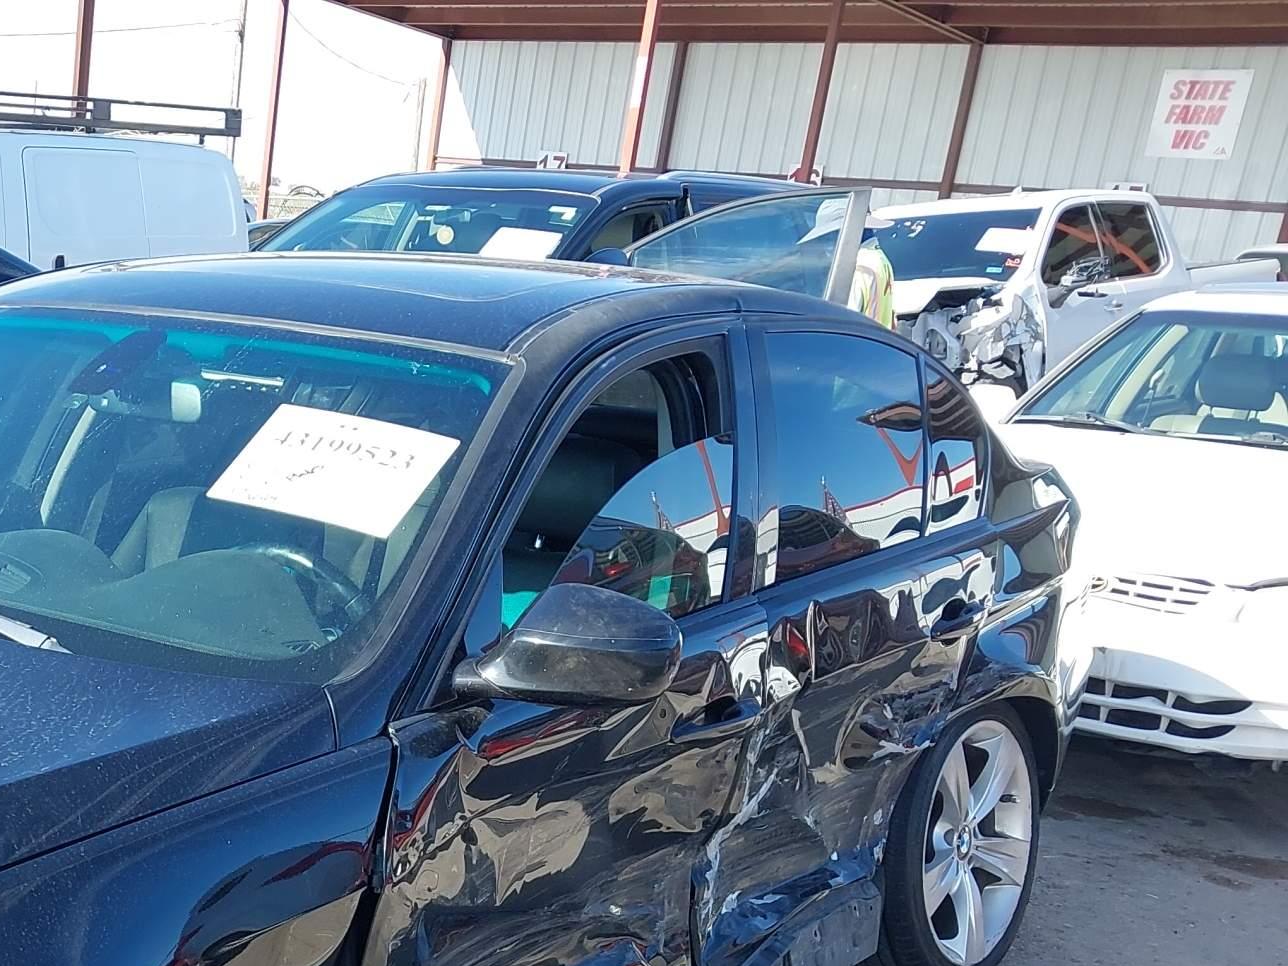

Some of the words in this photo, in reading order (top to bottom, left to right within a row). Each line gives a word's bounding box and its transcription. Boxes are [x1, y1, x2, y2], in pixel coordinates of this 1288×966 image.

[1169, 79, 1236, 101] STATE
[1164, 104, 1227, 126] FARM
[1170, 129, 1211, 151] VIC
